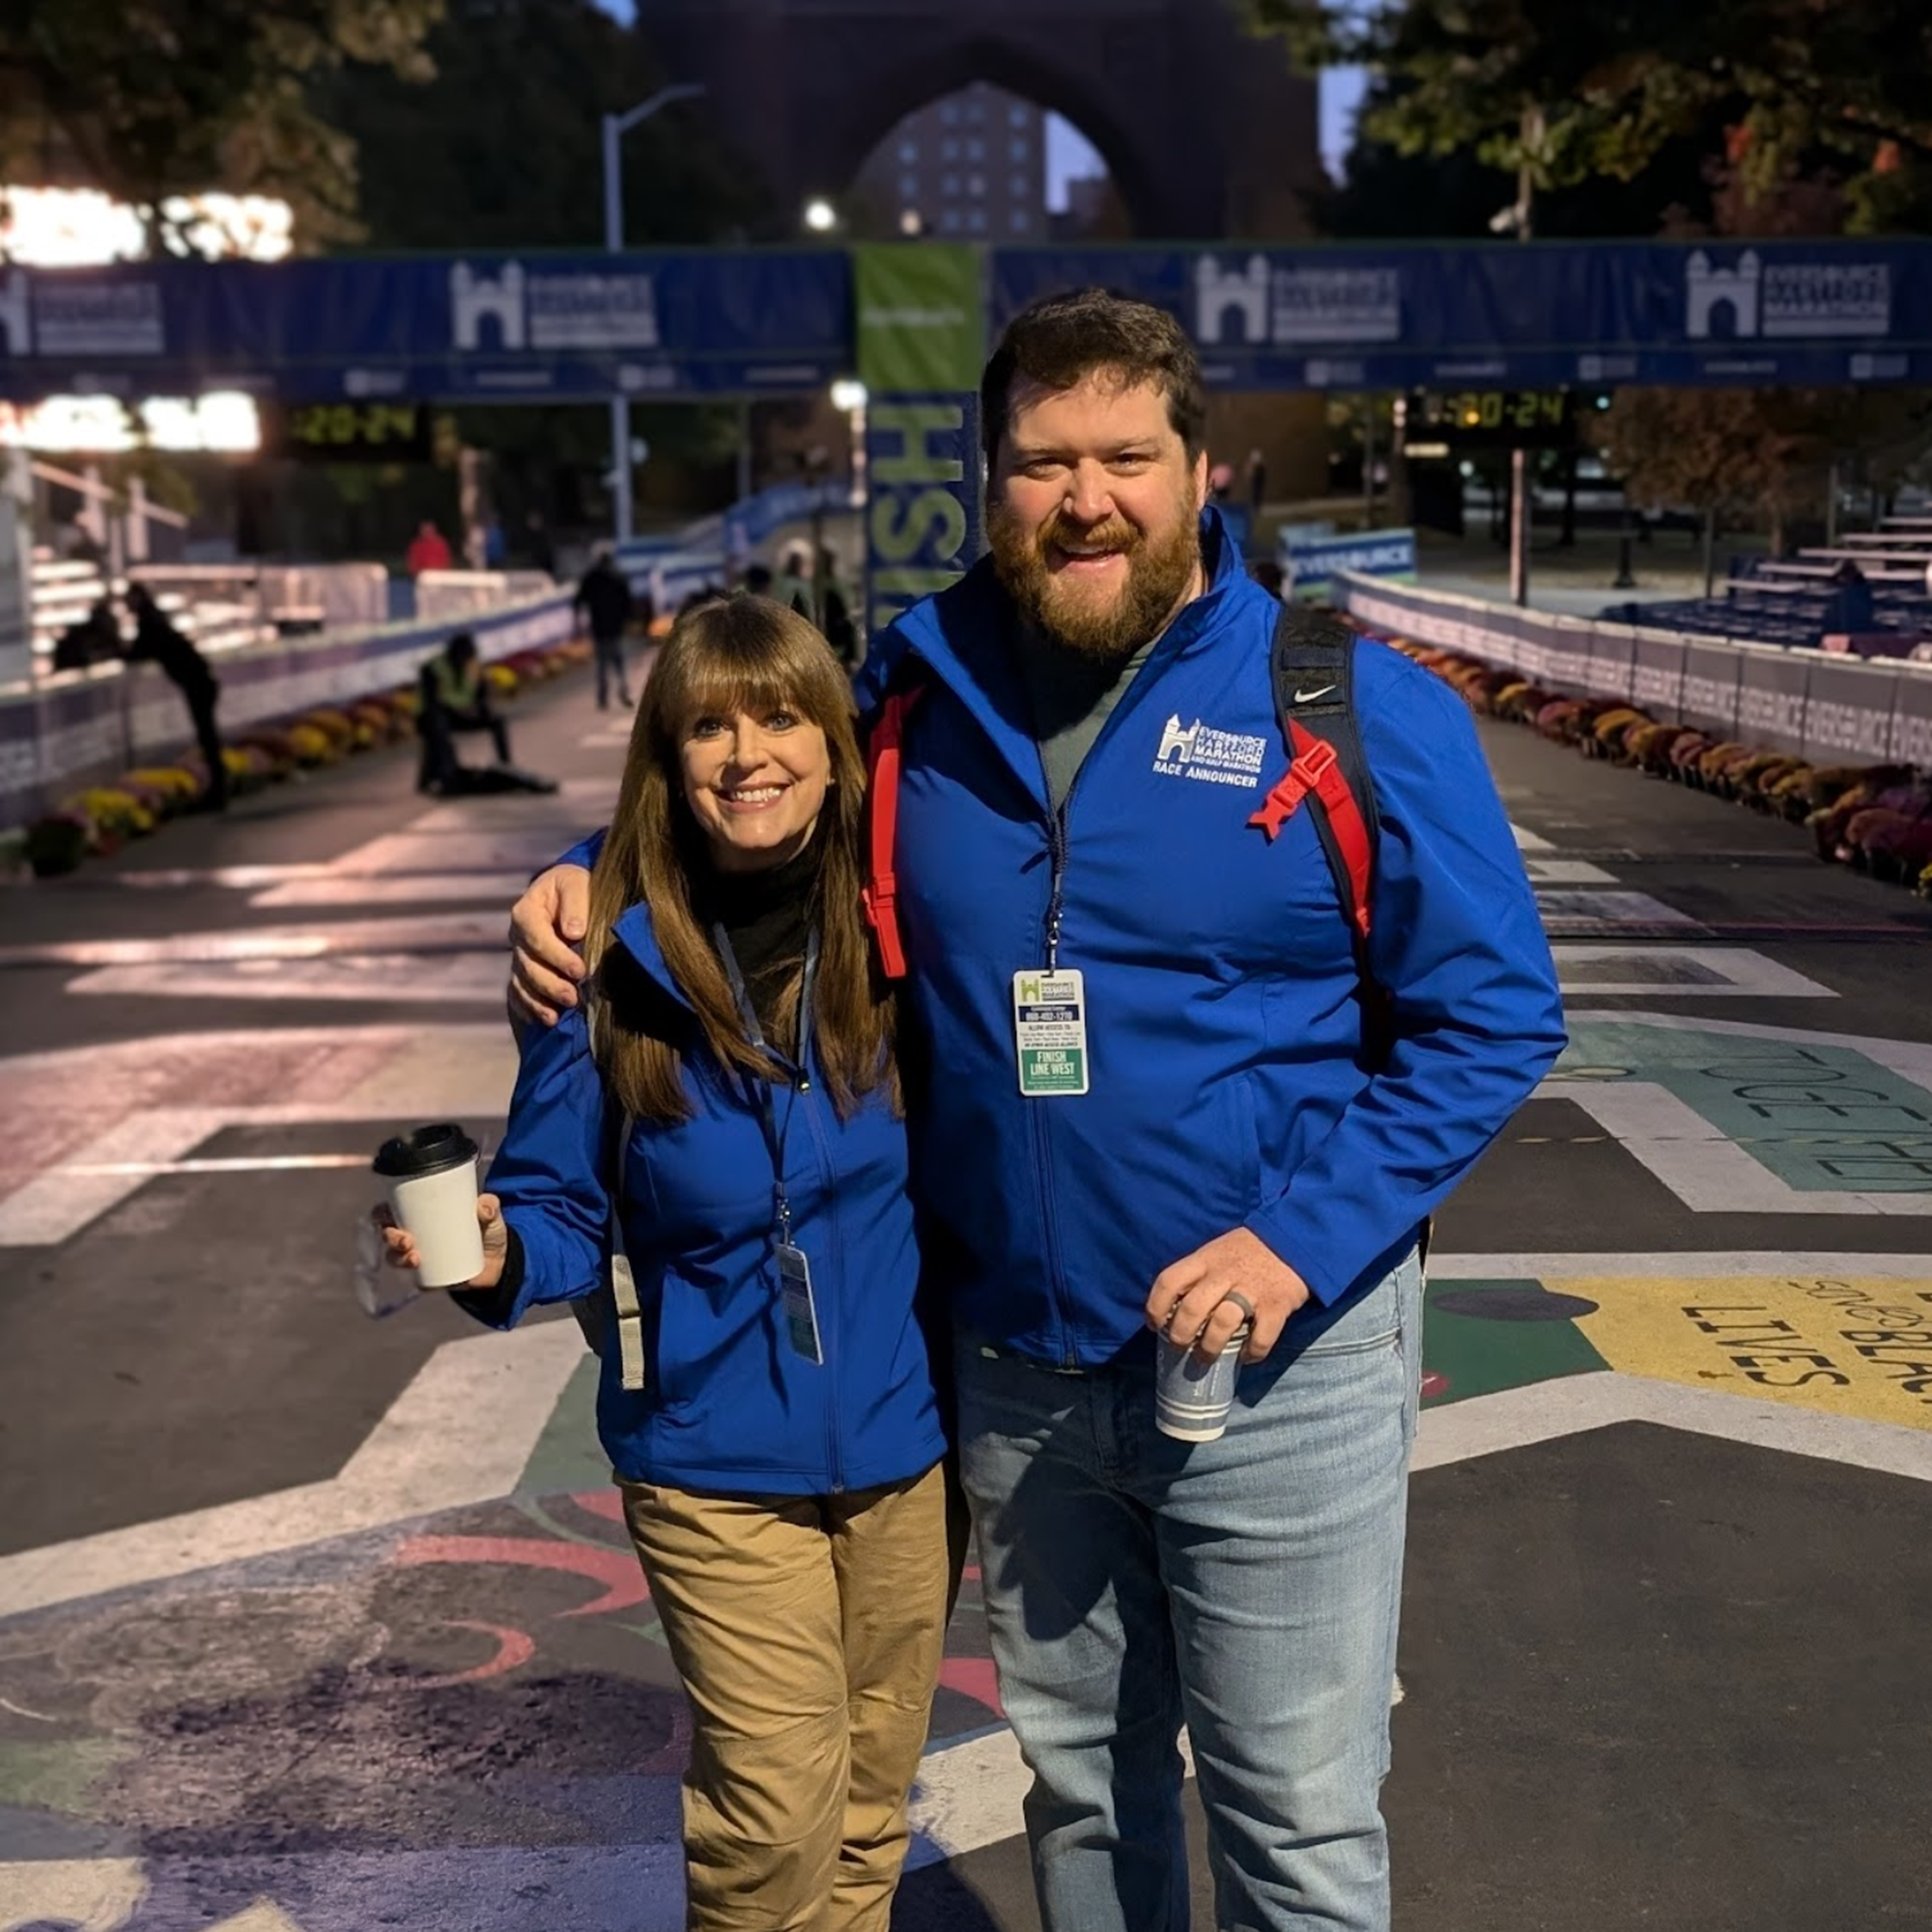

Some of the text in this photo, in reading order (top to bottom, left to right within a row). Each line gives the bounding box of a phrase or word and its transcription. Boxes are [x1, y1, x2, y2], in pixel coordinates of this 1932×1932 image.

[1195, 746, 1263, 766] MARATHON
[1152, 761, 1258, 788] RACE ANNOUNCER
[1037, 1051, 1066, 1062] FINISH
[1030, 1062, 1075, 1075] LINE WEST
[1682, 1305, 1850, 1387] LIVES
